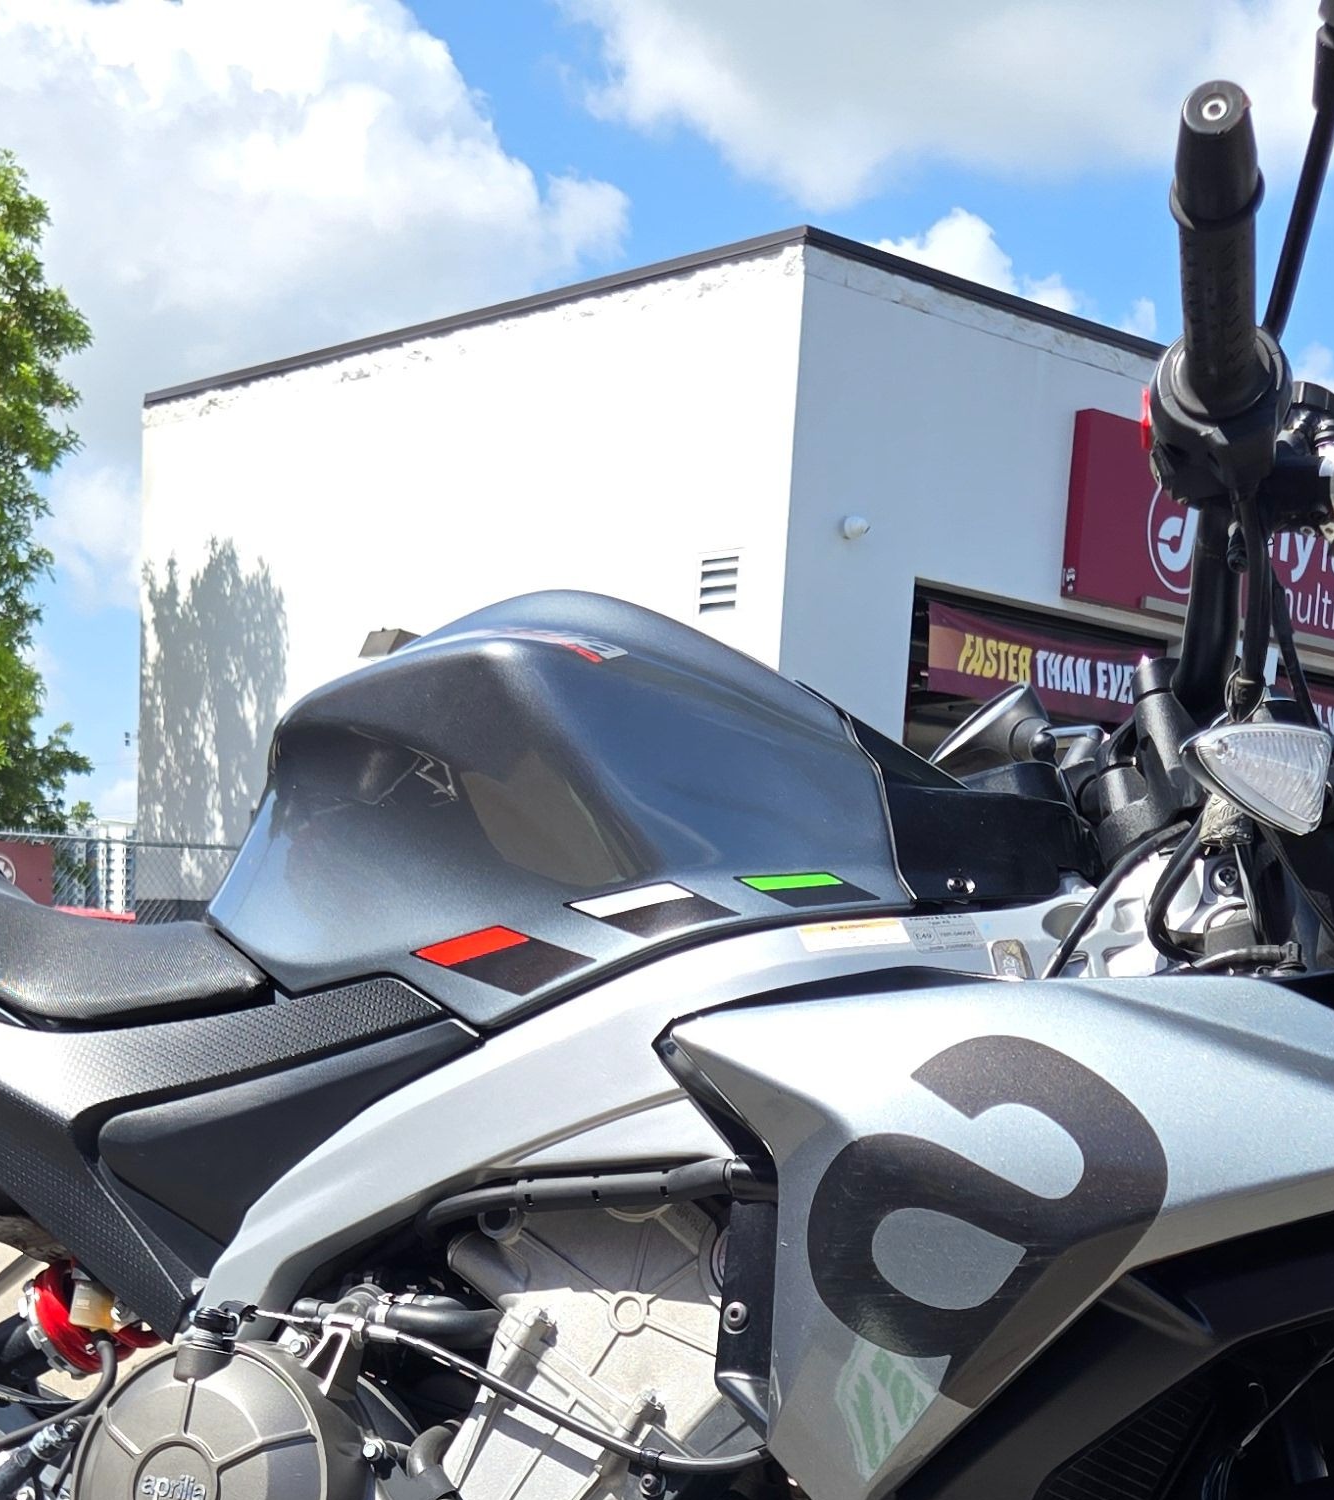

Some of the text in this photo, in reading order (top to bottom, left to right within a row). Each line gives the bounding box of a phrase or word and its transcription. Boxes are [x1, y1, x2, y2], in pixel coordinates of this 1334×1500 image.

[957, 633, 1137, 705] FASTER THAN EVE
